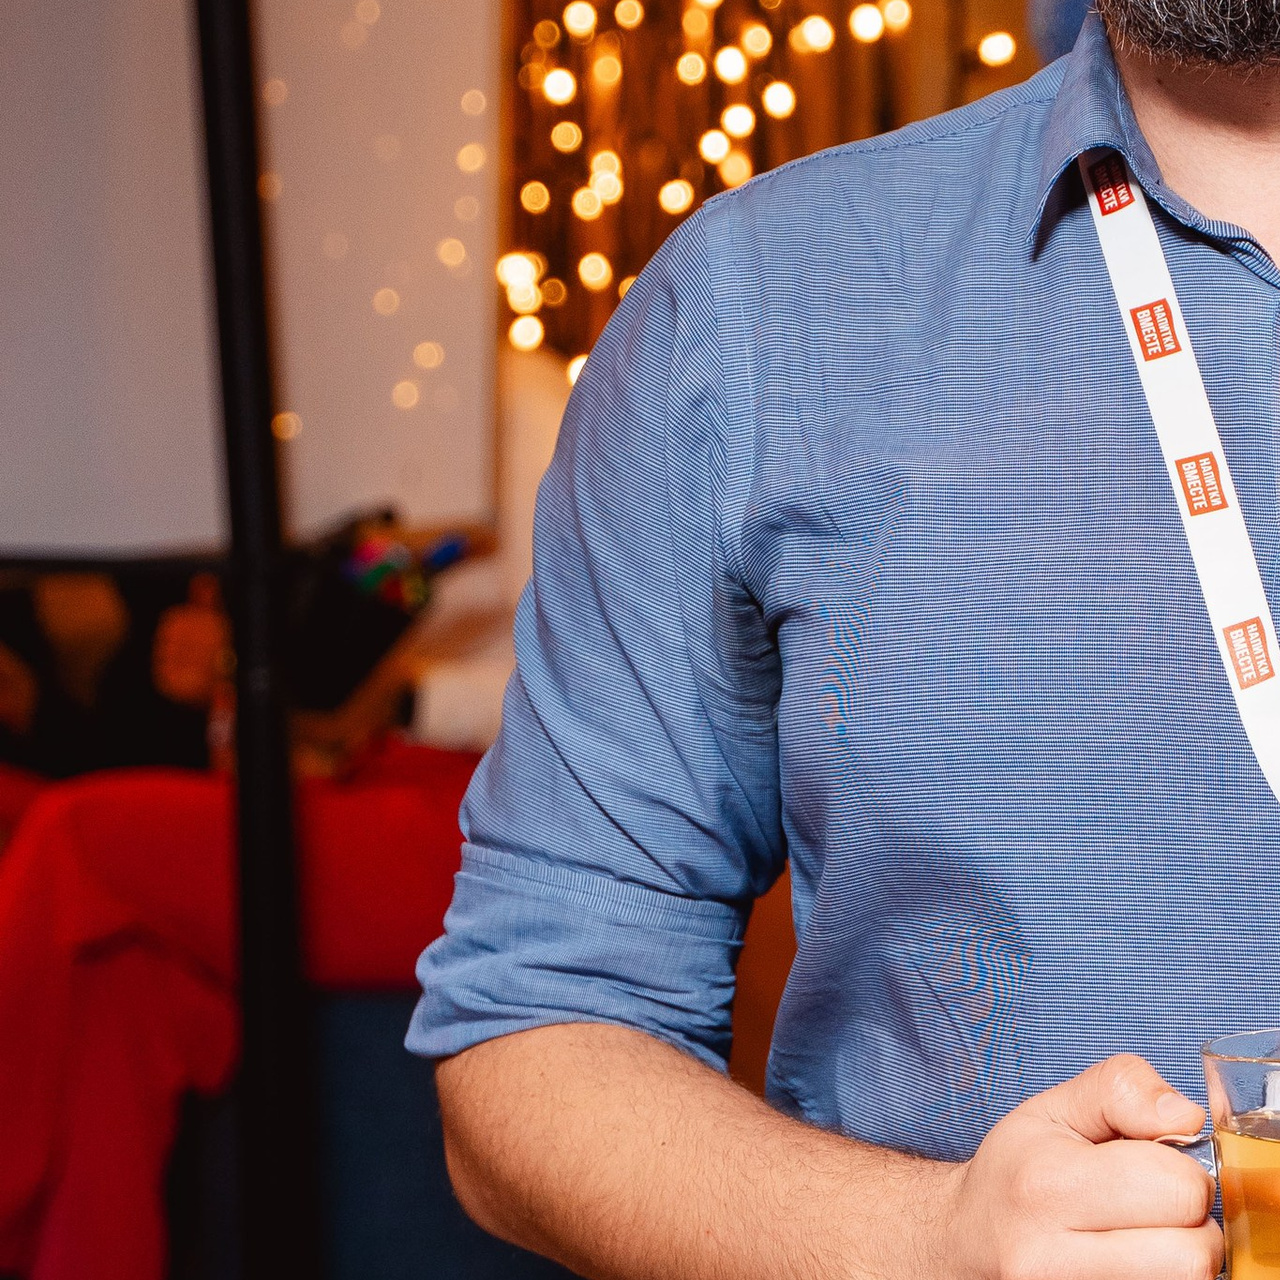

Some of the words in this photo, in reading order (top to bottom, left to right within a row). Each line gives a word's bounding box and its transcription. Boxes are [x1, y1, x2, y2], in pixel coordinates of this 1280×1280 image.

[1137, 309, 1160, 356] ВМЕСТЕ
[1153, 304, 1176, 351] НАПИТКИ
[1182, 462, 1207, 510] ВМЕСТЕ
[1199, 458, 1222, 505] НАПИТКИ
[1230, 629, 1256, 681] ВМЕСТЕ
[1247, 623, 1269, 677] НАПИТКИ
